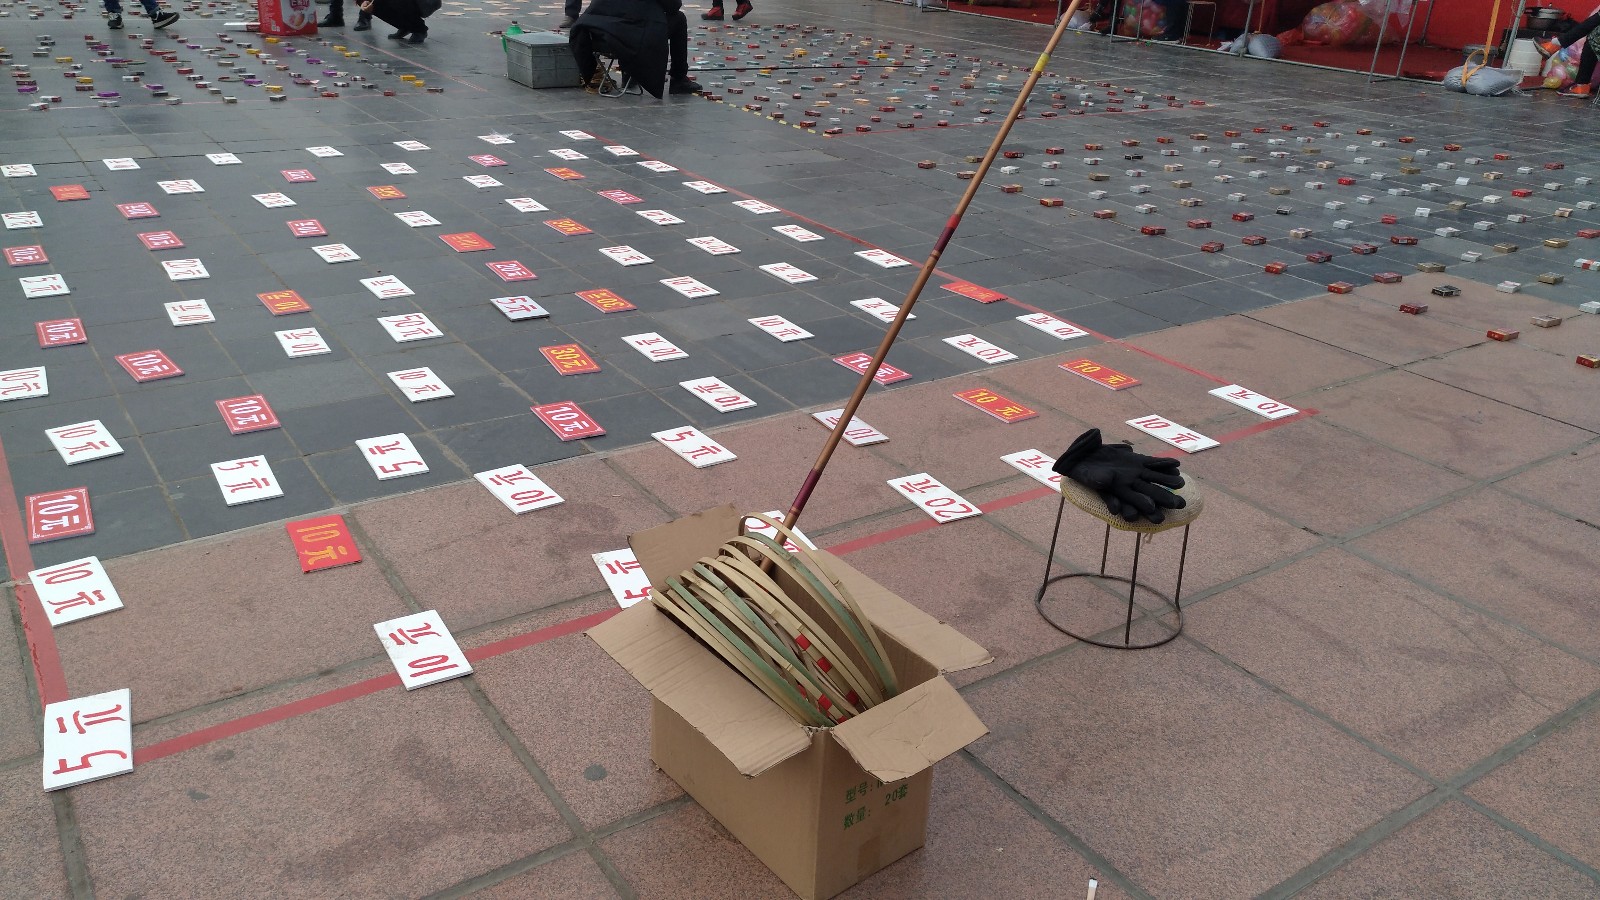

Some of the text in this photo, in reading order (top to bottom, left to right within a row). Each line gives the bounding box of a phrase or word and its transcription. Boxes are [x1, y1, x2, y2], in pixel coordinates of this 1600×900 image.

[17, 247, 40, 262] 10元
[166, 259, 201, 277] 20元
[498, 262, 527, 279] 20元
[23, 276, 62, 292] 5元
[268, 291, 302, 310] 10元
[496, 296, 538, 314] 5元
[590, 291, 625, 308] 30元
[46, 320, 77, 341] 10元
[386, 314, 434, 338] 50元
[758, 318, 803, 338] 10元
[1031, 314, 1077, 337] 10元
[283, 328, 327, 353] 10元
[634, 335, 684, 357] 10元
[956, 338, 1009, 362] 10元
[128, 354, 170, 375] 10元
[551, 347, 589, 369] 30元
[0, 369, 41, 396] 10元
[396, 370, 442, 395] 10元
[1075, 361, 1129, 386] 10元
[693, 382, 751, 408] 10元
[971, 391, 1024, 418] 10元
[1226, 388, 1290, 415] 10元
[227, 399, 267, 425] 10元
[545, 404, 596, 432] 10元
[52, 424, 110, 456] 10元
[1138, 417, 1199, 444] 10元
[369, 440, 424, 474] 5元
[661, 431, 723, 460] 5元
[217, 458, 270, 493] 5元
[489, 470, 556, 507] 10元
[900, 477, 974, 520] 20元
[38, 494, 80, 531] 10元
[296, 522, 349, 565] 10元
[38, 562, 106, 616] 10元
[390, 621, 460, 679] 10元
[53, 704, 128, 776] 5元
